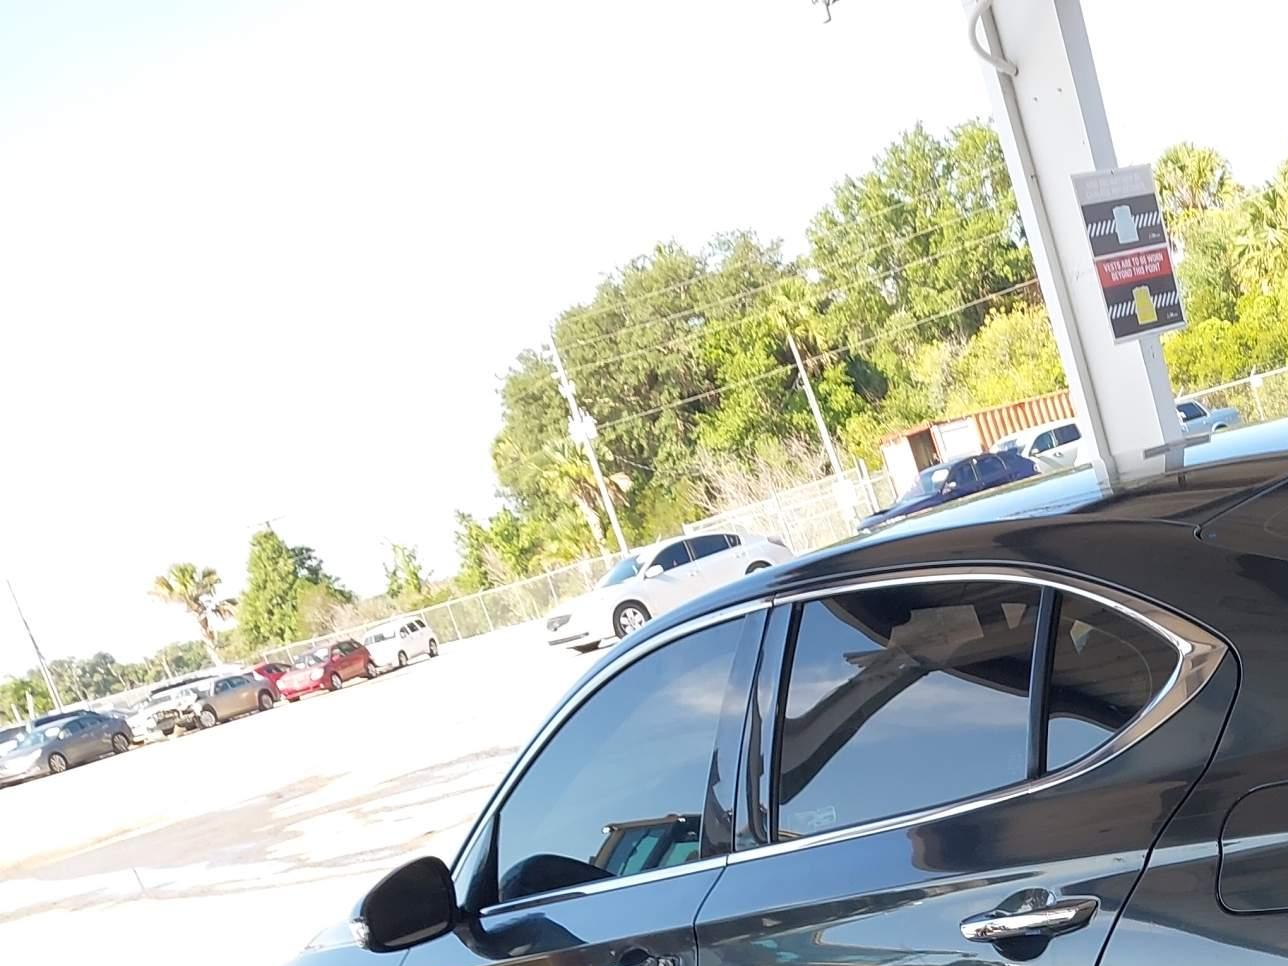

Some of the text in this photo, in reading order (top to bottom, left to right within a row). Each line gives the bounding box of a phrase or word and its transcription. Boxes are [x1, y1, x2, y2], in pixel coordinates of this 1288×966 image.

[1132, 257, 1140, 266] TO
[1111, 263, 1161, 282] BEYOND THIS POINT
